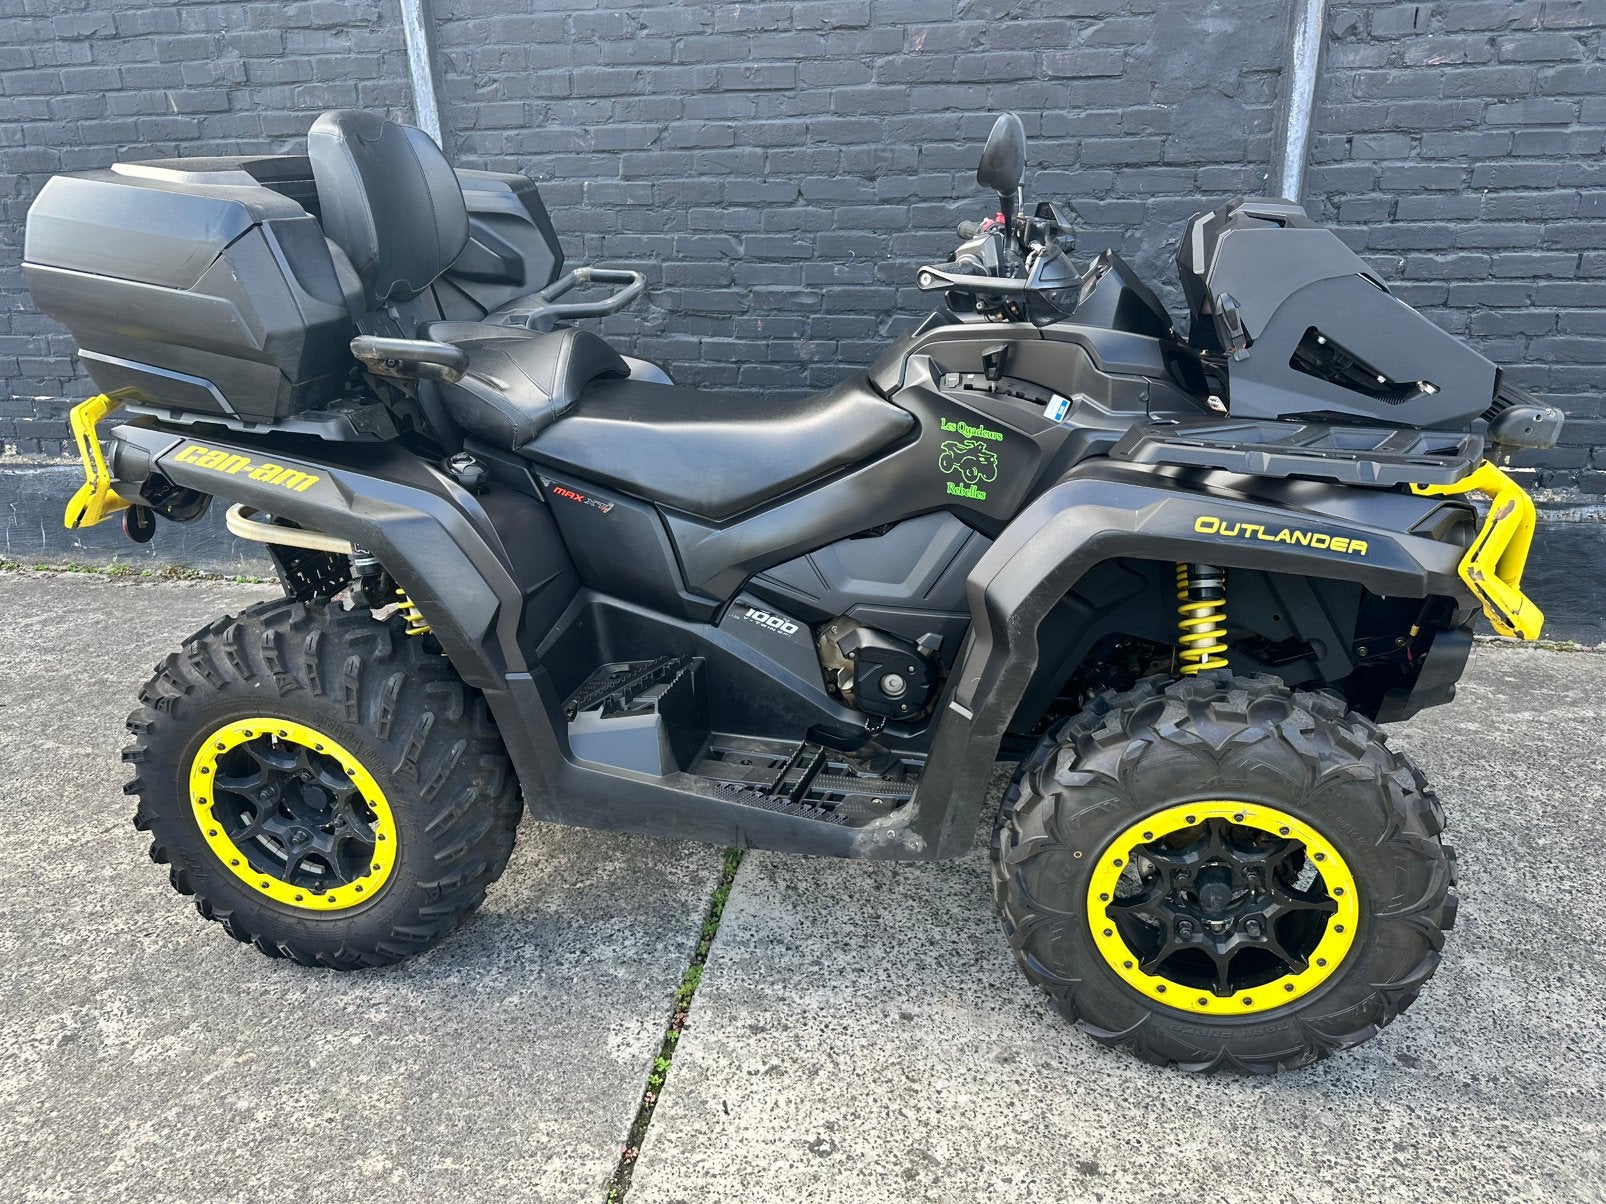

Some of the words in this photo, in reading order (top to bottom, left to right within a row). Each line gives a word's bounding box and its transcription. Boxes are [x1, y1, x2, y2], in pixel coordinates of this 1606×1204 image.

[941, 417, 957, 431] Les
[957, 421, 1004, 441] Quadeurs
[174, 445, 320, 492] can-am
[553, 486, 585, 503] MAX
[946, 481, 987, 500] Rebelles
[1194, 516, 1368, 556] OUTLANDER
[745, 608, 799, 634] 1000
